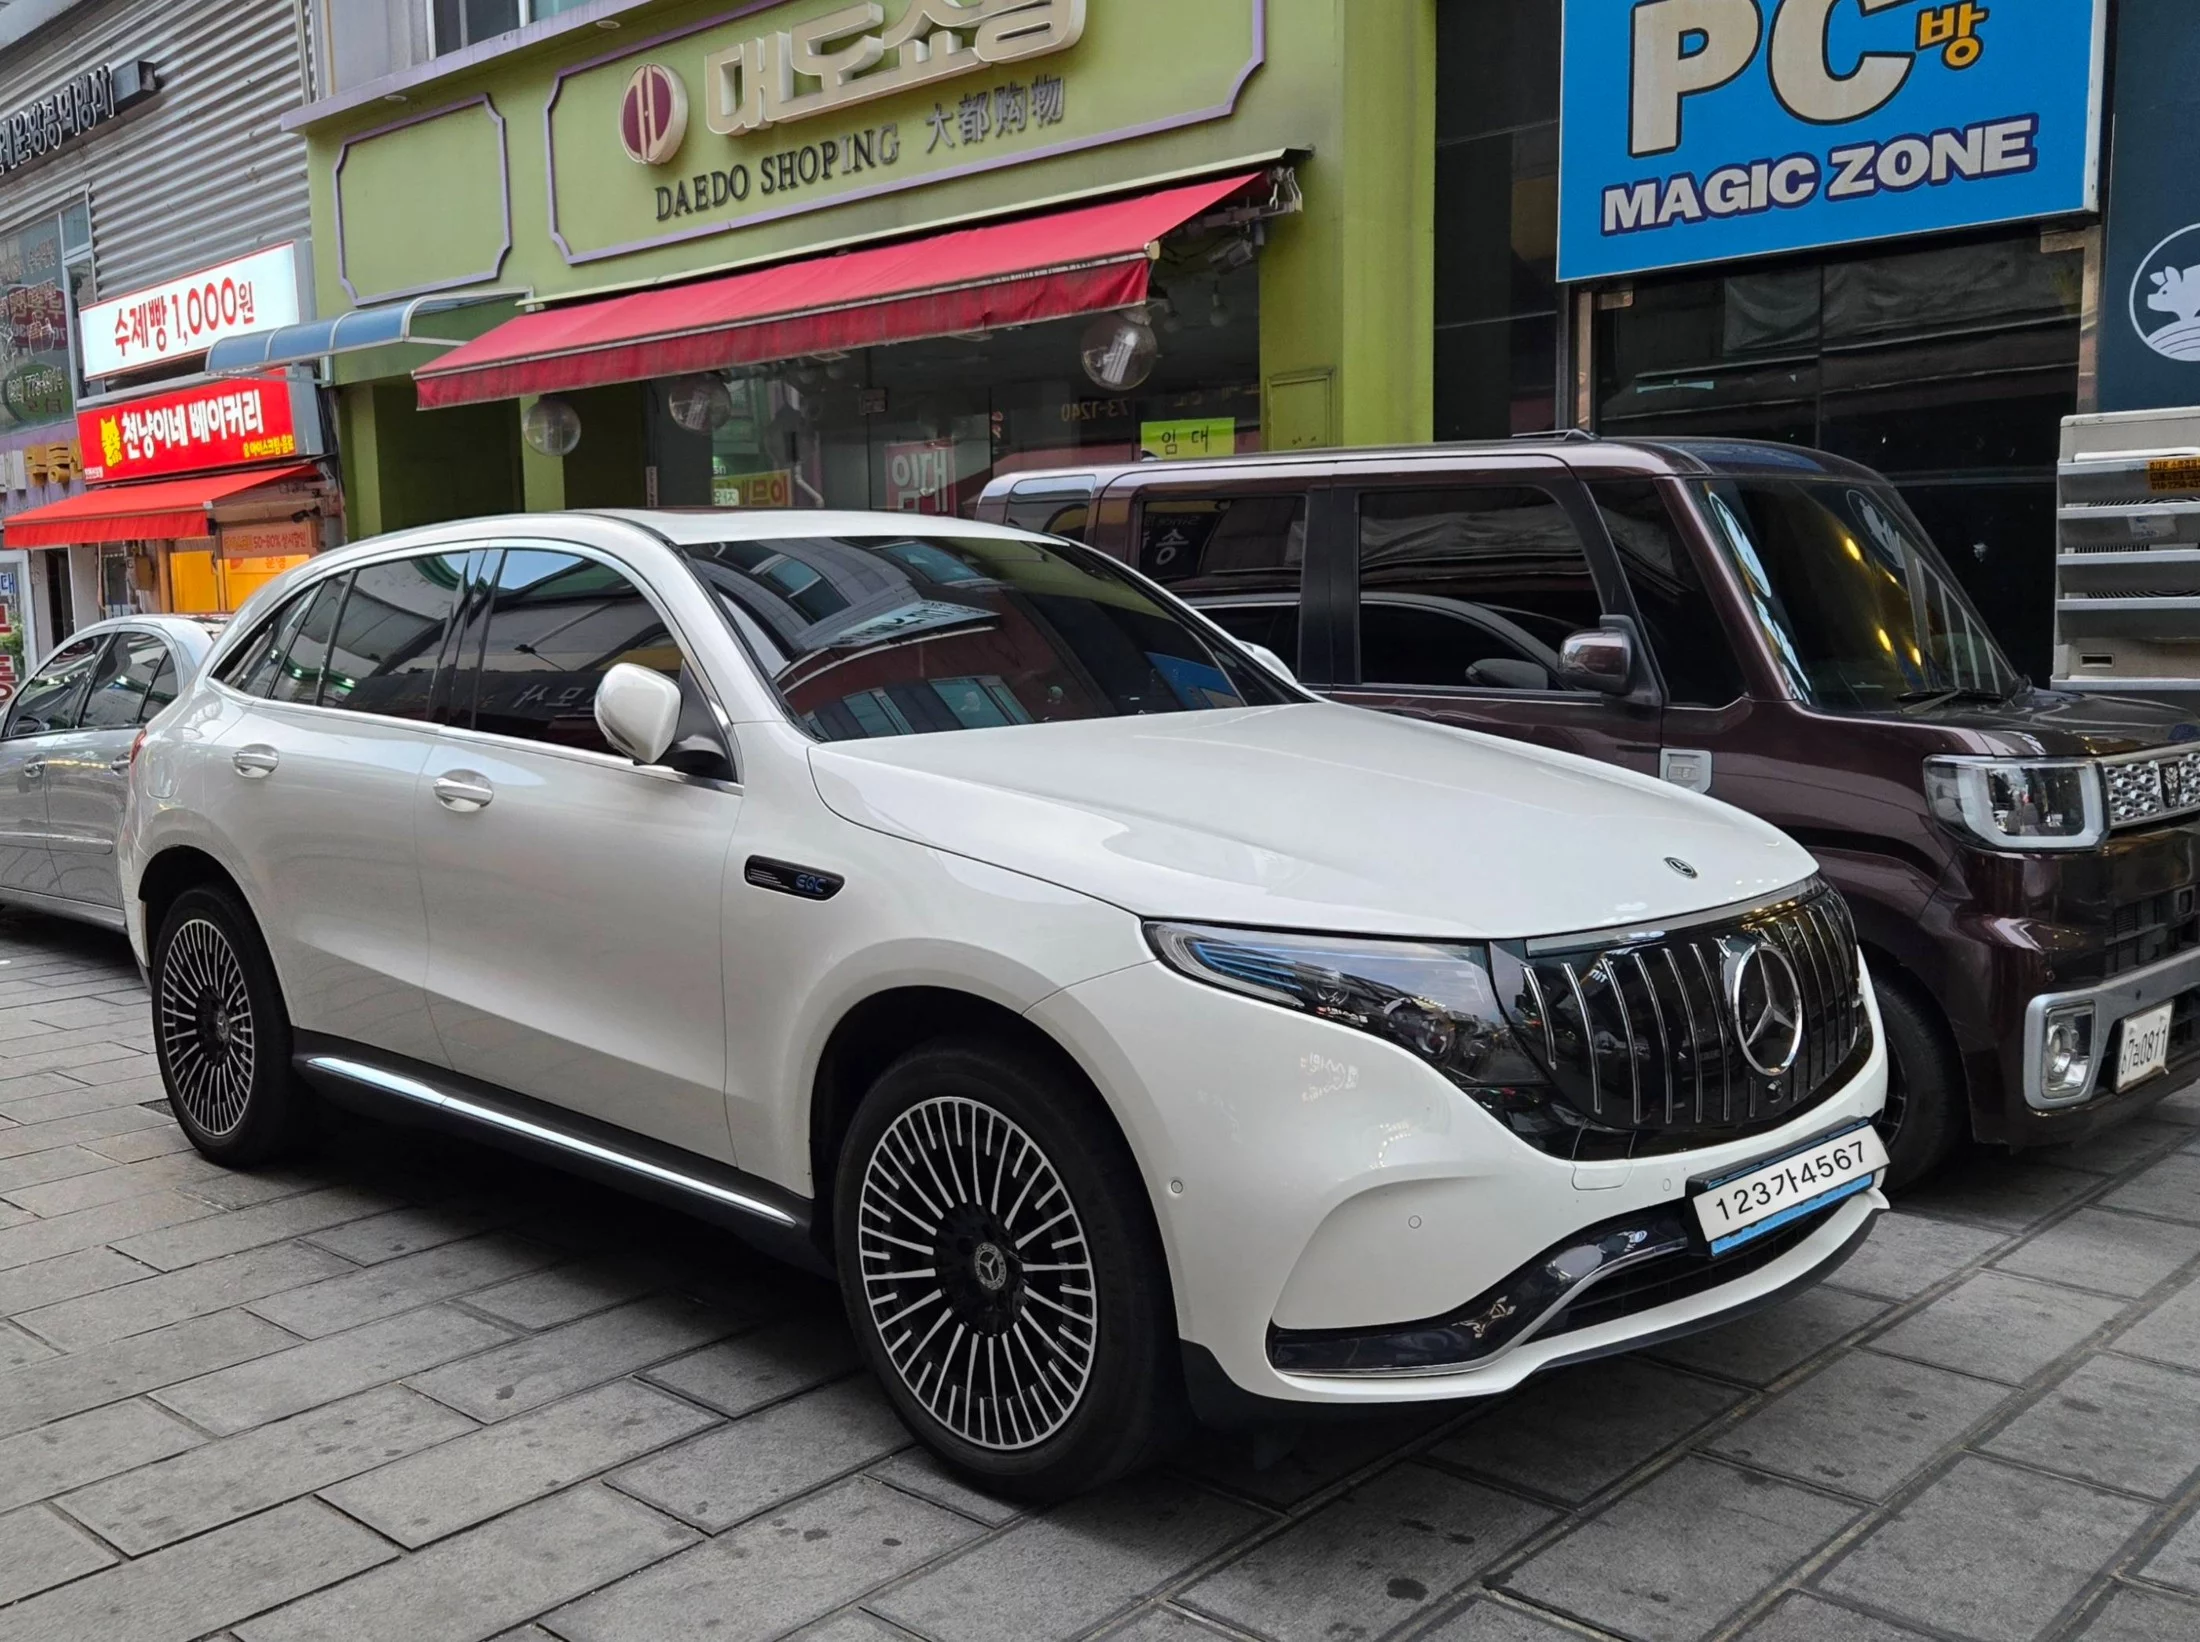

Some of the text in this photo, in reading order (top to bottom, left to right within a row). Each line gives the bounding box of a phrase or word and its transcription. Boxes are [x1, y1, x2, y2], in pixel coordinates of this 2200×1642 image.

[924, 74, 1065, 154] 大都购物
[655, 122, 900, 221] DAEDO SHOPING
[1602, 117, 2035, 233] MAGIC ZONE
[115, 295, 167, 357] 수제빵
[171, 277, 255, 347] 1,000원
[121, 389, 264, 460] 천냥이네 베이커리
[0, 573, 15, 596] 대
[795, 873, 827, 893] EQC
[1715, 1140, 1865, 1221] 123가4567
